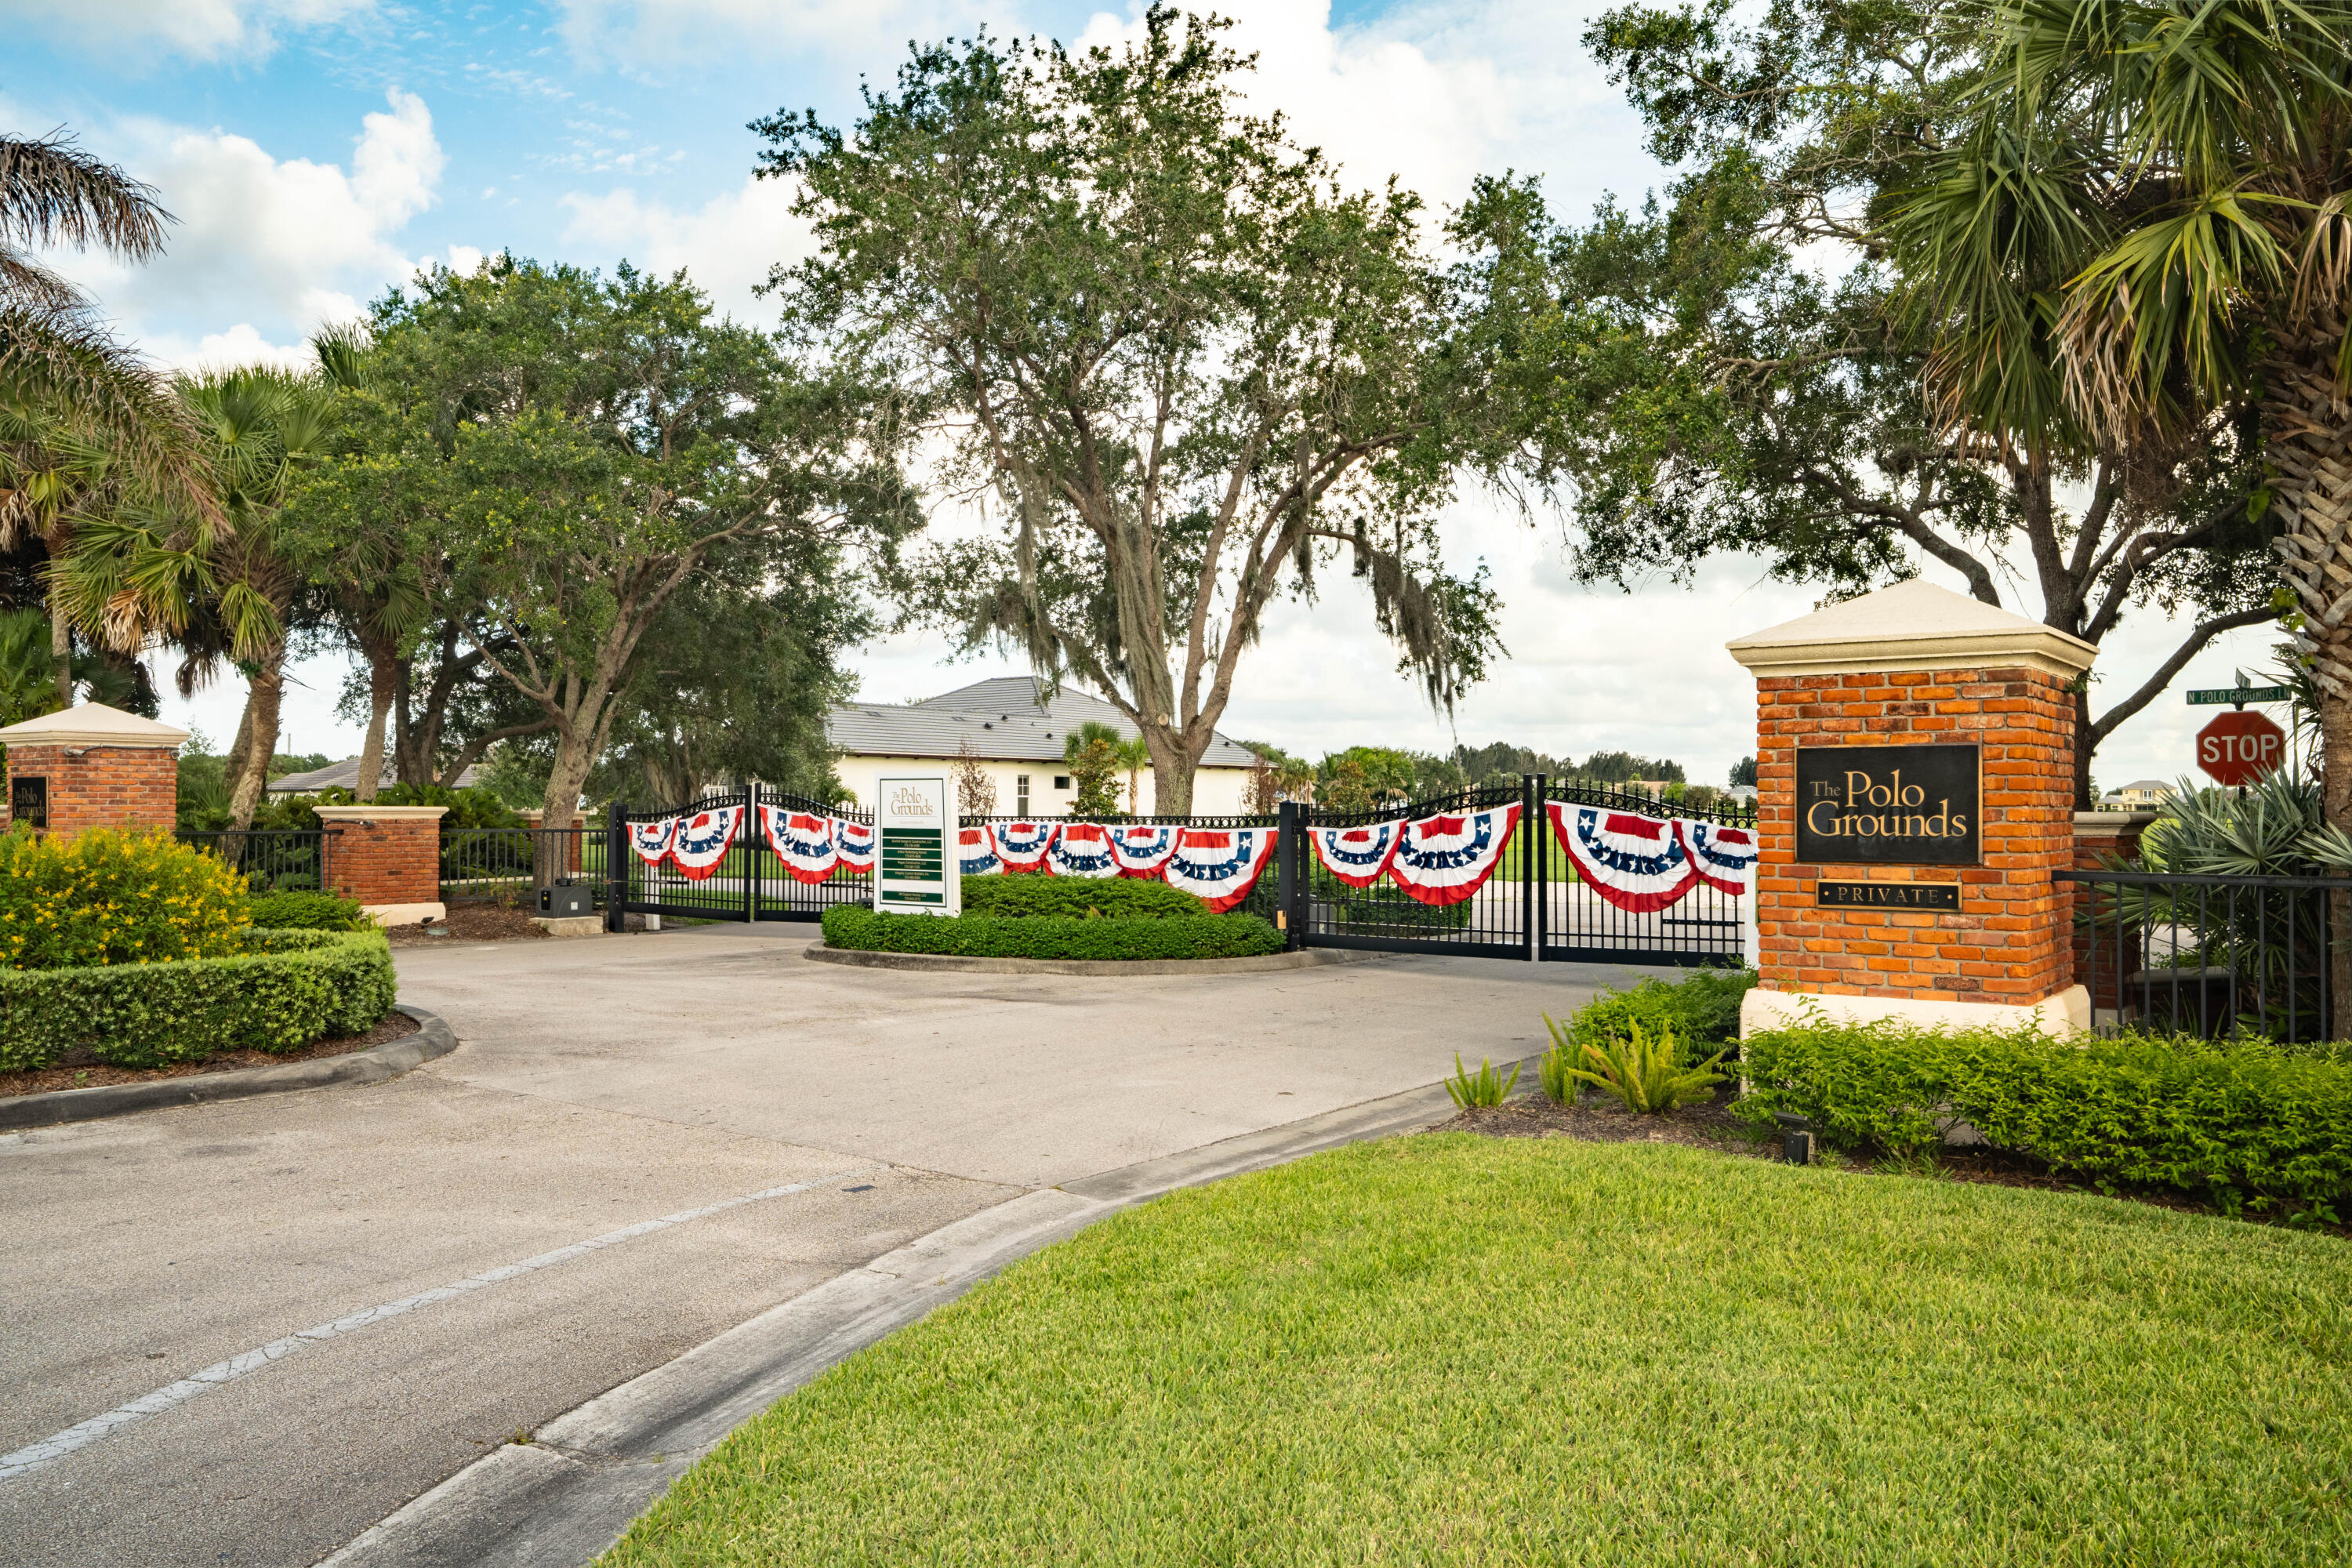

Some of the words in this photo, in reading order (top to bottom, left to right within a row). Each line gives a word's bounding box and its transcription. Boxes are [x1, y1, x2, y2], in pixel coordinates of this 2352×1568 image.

[2188, 692, 2195, 703] N
[2200, 691, 2225, 703] POLO
[2229, 688, 2274, 702] GROUNDS
[2278, 688, 2291, 700] LN
[2202, 734, 2279, 763] STOP
[21, 786, 38, 804] Polo
[900, 786, 922, 804] Polo
[1809, 780, 1842, 797] The
[1843, 768, 1925, 808] Polo
[13, 799, 45, 816] Grounds
[891, 798, 933, 815] Grounds
[1806, 797, 1968, 839] Grounds
[1837, 887, 1940, 904] PRIVATE
